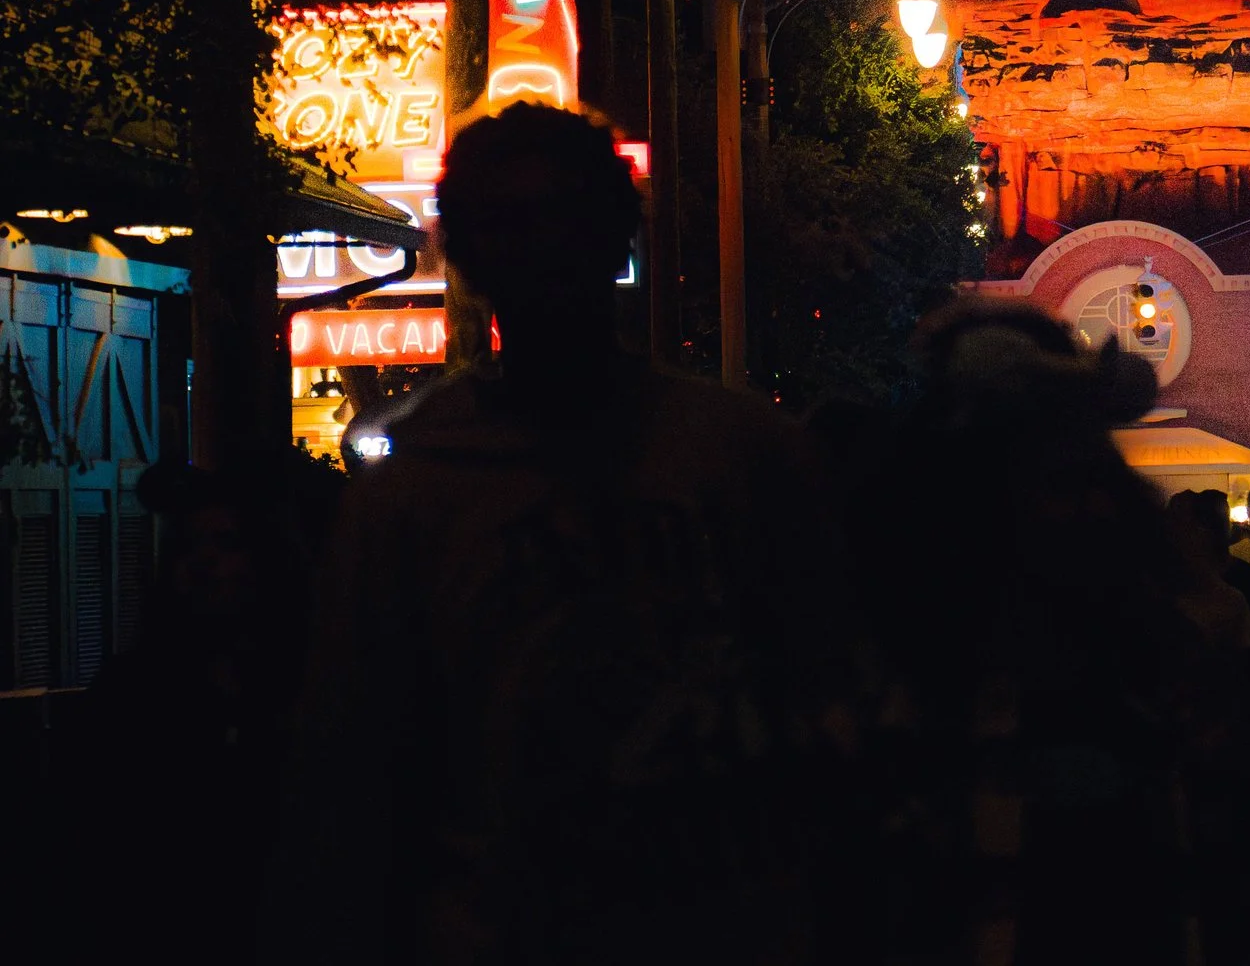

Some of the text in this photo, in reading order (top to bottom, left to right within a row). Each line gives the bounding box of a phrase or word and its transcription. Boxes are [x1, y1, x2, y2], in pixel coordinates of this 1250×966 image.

[272, 22, 438, 79] OZY
[273, 90, 439, 147] ONE
[326, 321, 447, 356] VACAN
